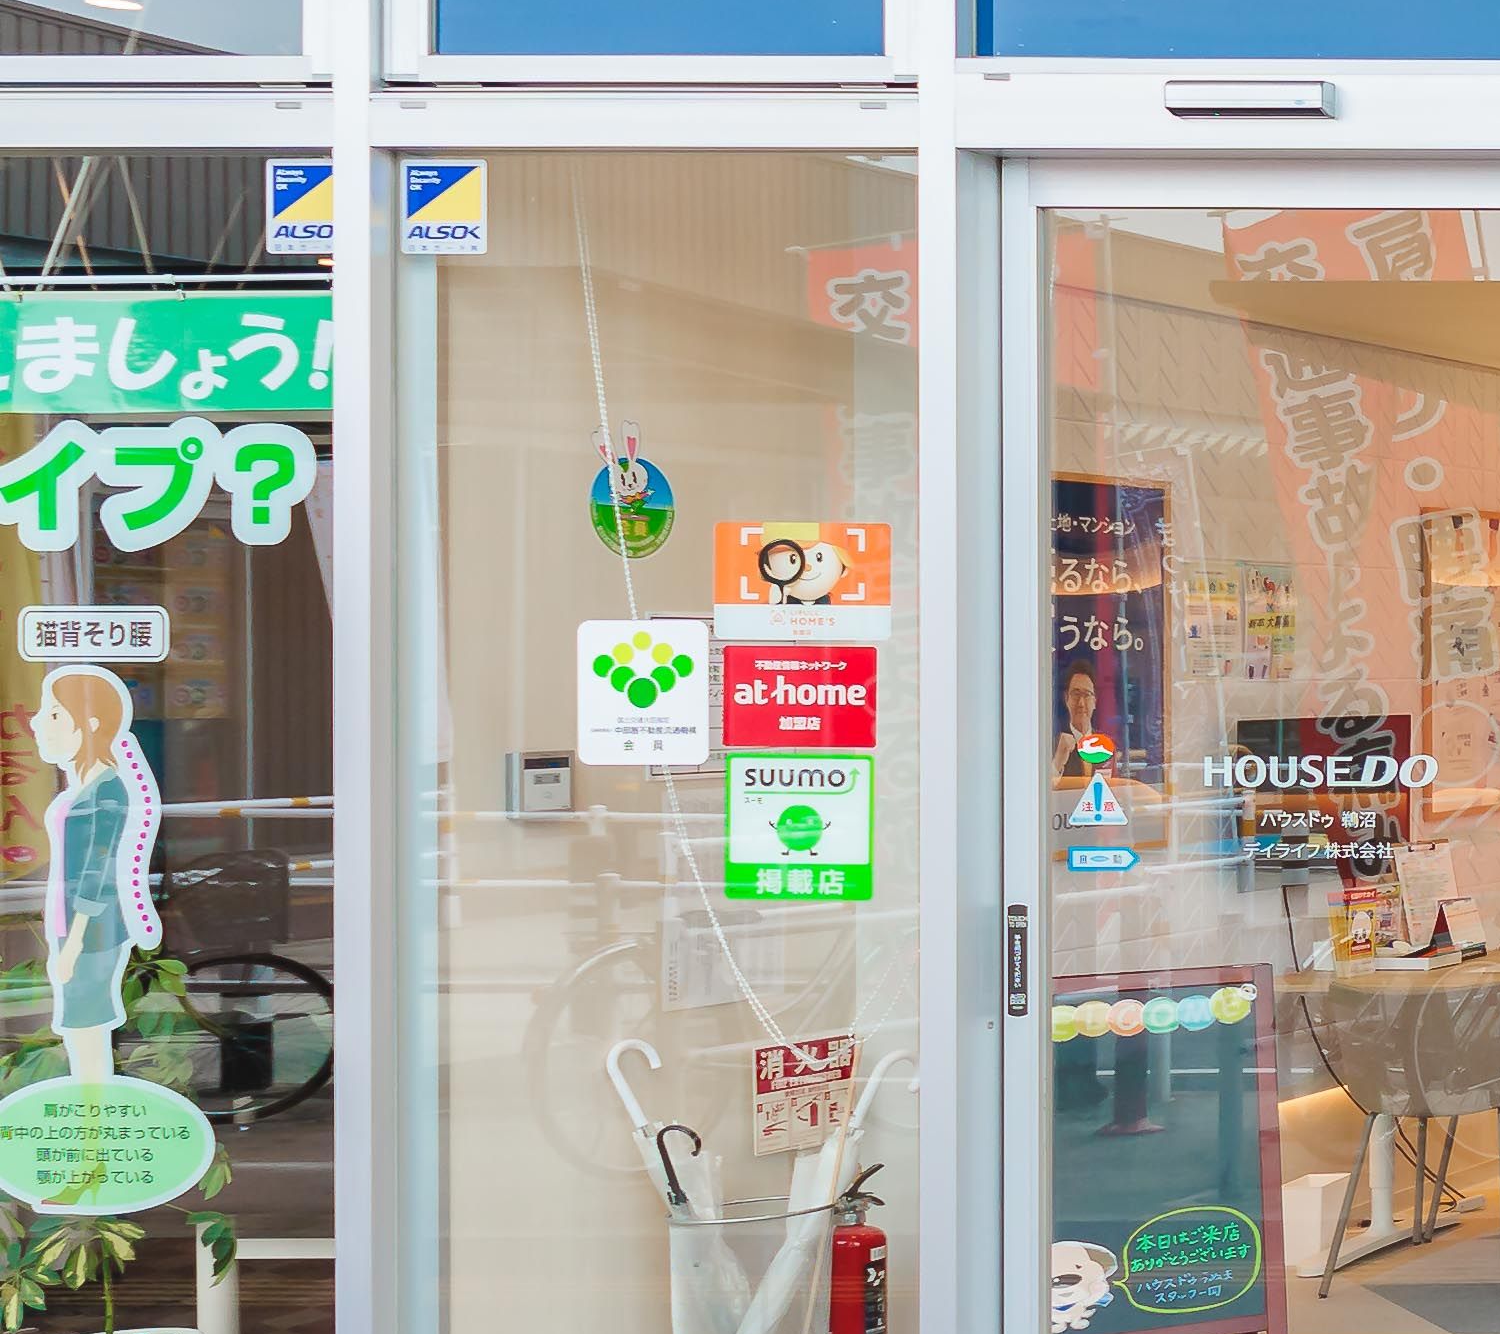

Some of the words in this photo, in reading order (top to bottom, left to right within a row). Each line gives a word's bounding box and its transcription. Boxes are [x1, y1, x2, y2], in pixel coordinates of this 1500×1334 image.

[407, 225, 481, 240] ALSOK
[1051, 550, 1143, 594] るなら、
[790, 617, 836, 627] HOME'S
[1051, 605, 1144, 651] うなら。
[36, 620, 152, 648] 猫背そり腰
[778, 716, 822, 731] 加盟店
[1260, 810, 1334, 829] ハウスドゥ
[1341, 810, 1377, 829] 鵜沼
[1243, 842, 1320, 860] デイライフ
[1323, 841, 1396, 860] 株式会社
[756, 868, 846, 896] 掲載店
[43, 1103, 147, 1118] 肩がこりやすい
[0, 1126, 191, 1141] 背中の上の方が丸まっている
[36, 1147, 154, 1163] 頭が前に出ている
[1135, 1221, 1241, 1253] 本日はご来店
[1130, 1243, 1252, 1273] ありがとうございます
[1154, 1284, 1222, 1304] スタッフ一同
